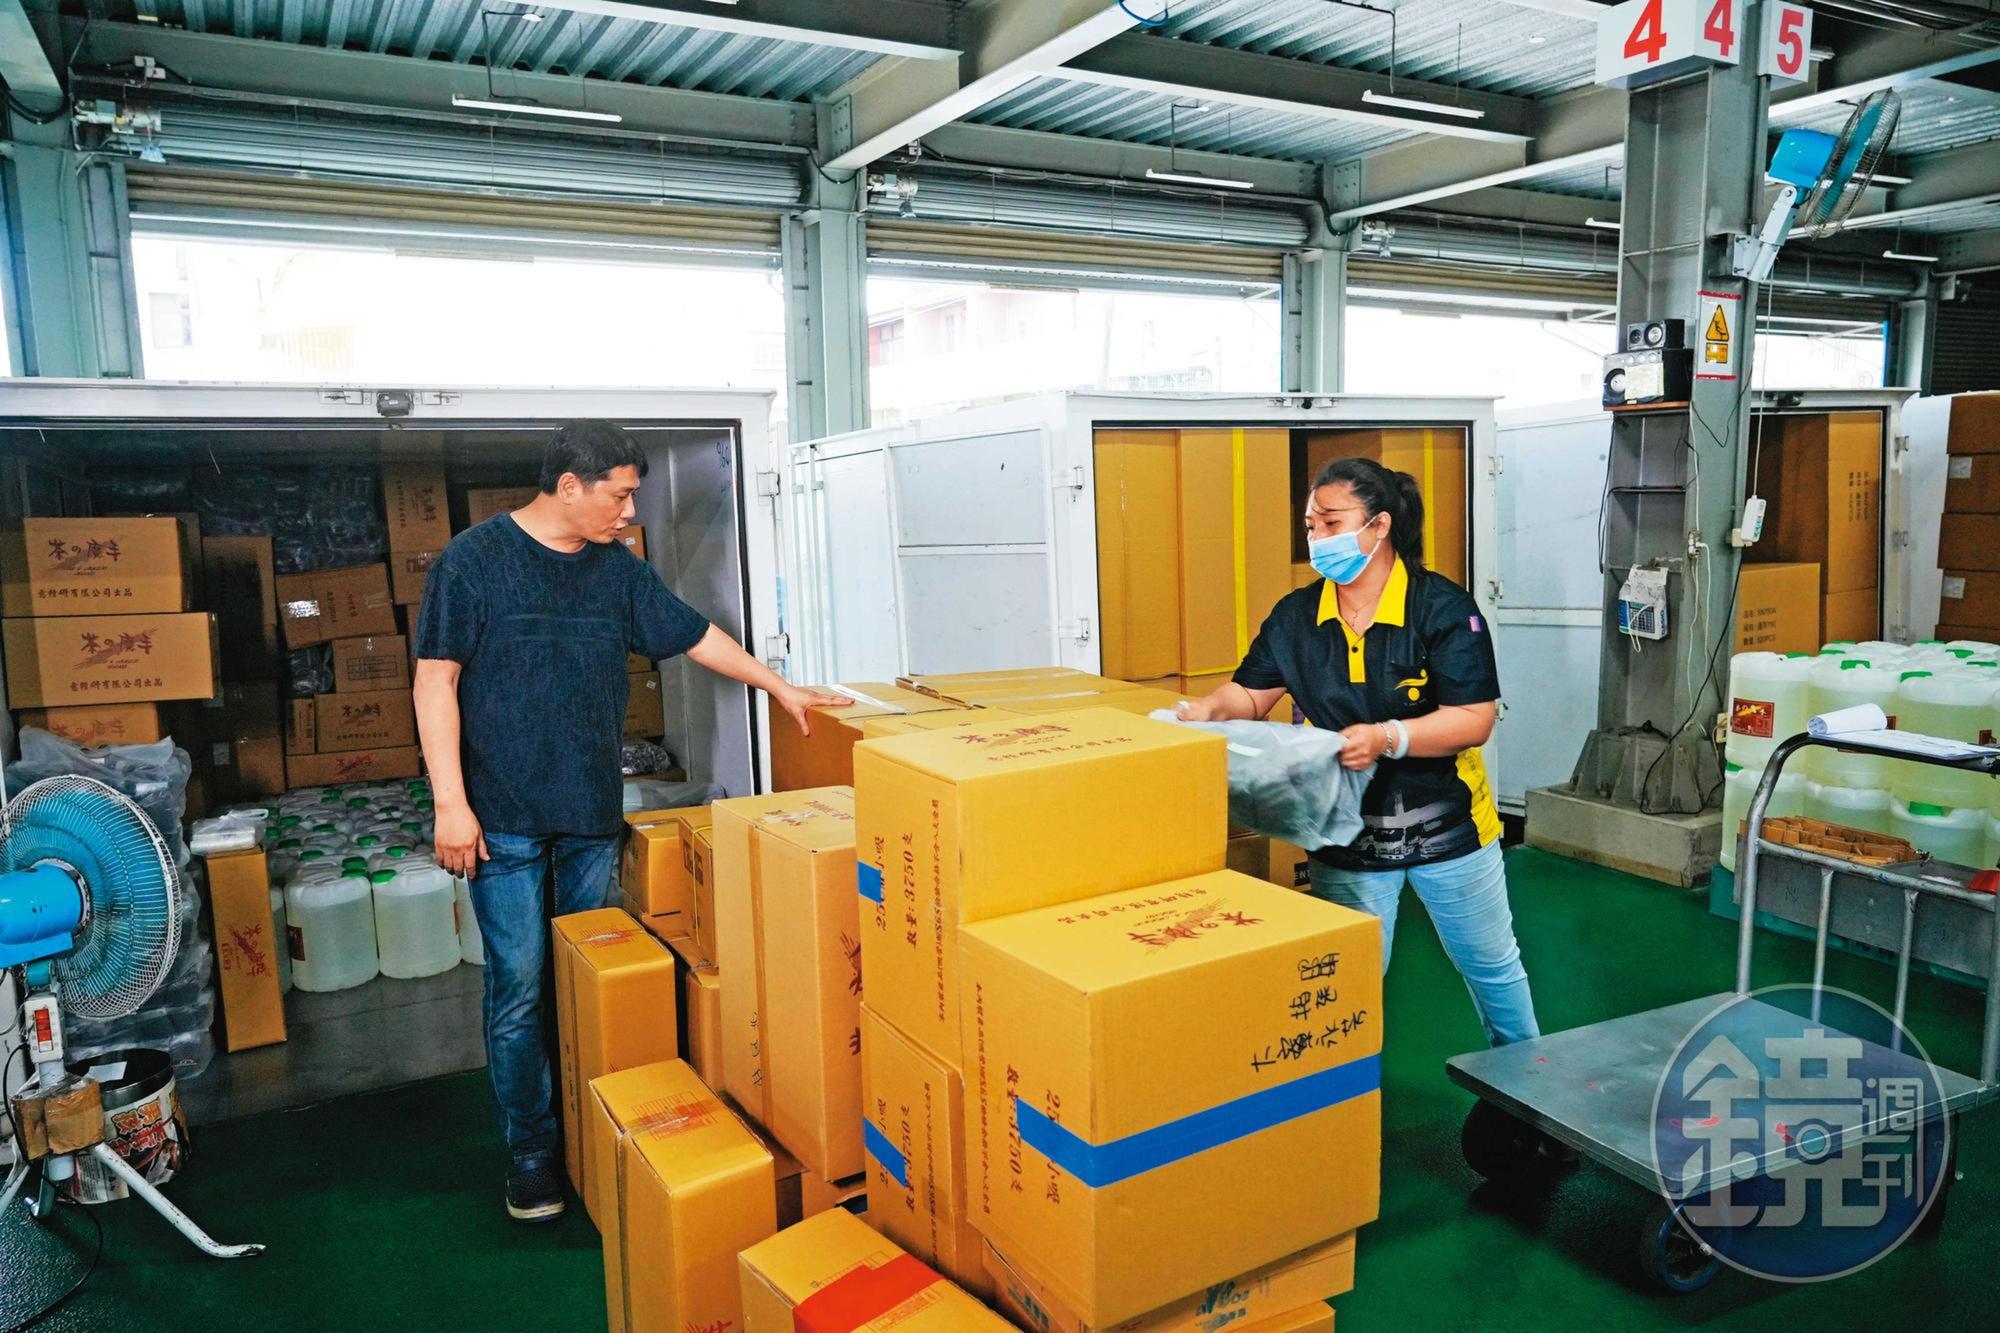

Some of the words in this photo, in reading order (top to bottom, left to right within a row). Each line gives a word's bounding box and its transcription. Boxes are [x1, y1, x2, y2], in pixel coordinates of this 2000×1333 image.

[1624, 0, 1667, 63] 4
[1704, 0, 1734, 57] 4
[1777, 9, 1804, 75] 5
